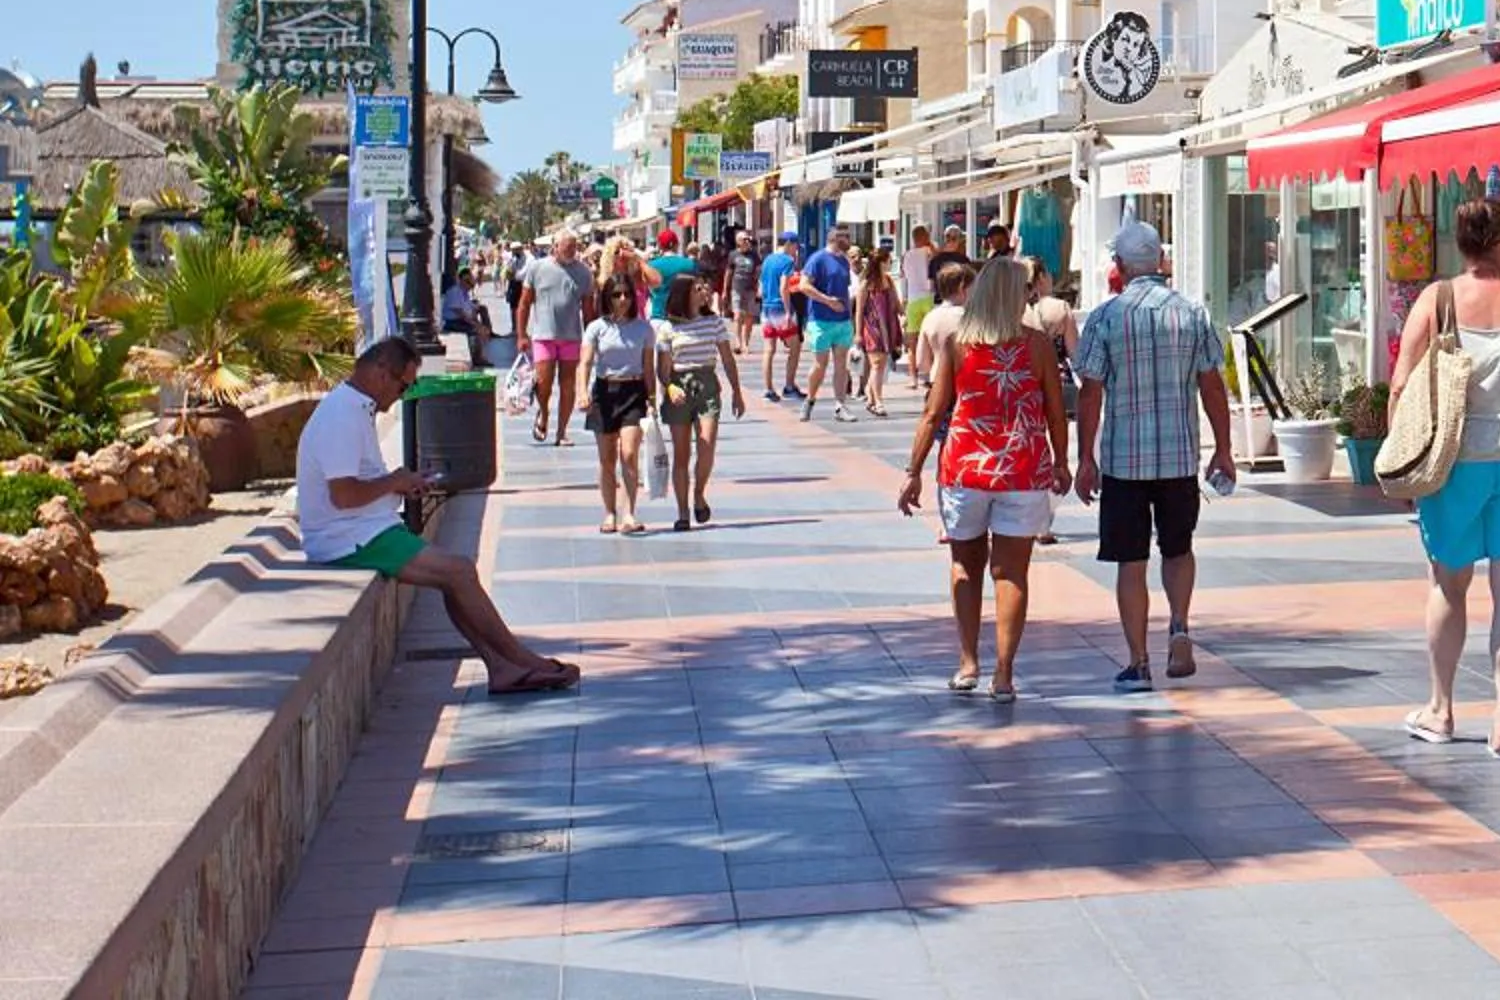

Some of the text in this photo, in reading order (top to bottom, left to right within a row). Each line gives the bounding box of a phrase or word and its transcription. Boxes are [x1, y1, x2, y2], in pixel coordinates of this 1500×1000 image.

[811, 60, 873, 73] CARIHUELA
[883, 59, 910, 75] CB
[837, 75, 873, 87] BEACH
